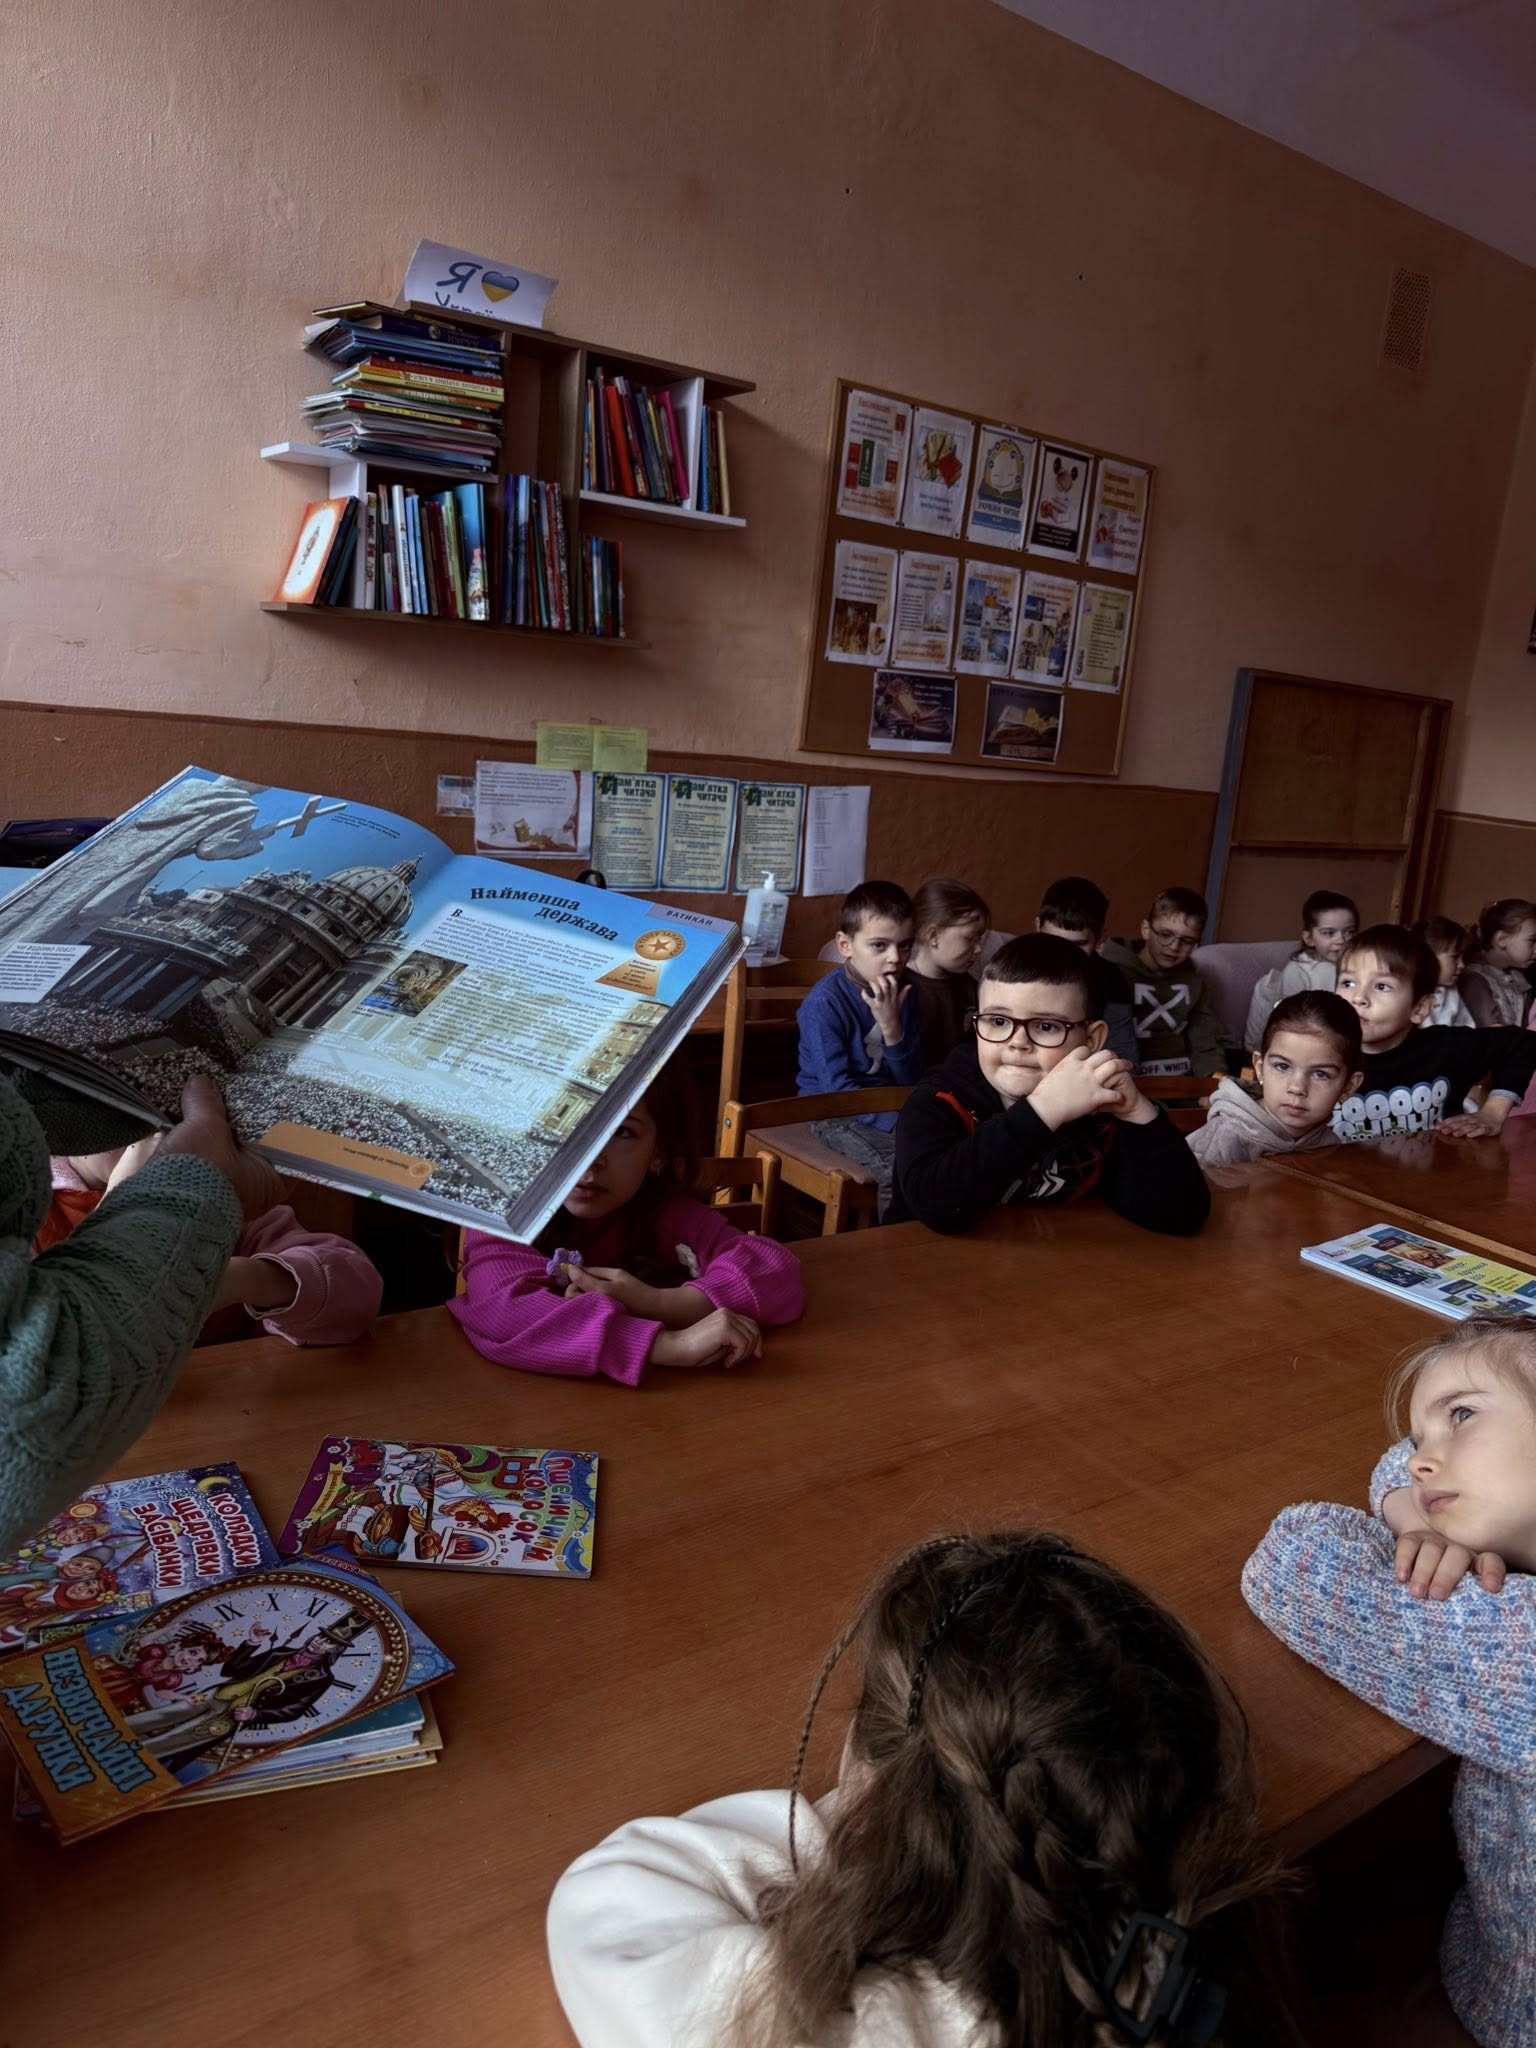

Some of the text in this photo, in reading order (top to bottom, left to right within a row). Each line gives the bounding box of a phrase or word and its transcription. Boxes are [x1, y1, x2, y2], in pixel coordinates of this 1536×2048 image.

[436, 262, 483, 293] Я
[623, 788, 656, 798] читача
[696, 792, 727, 803] читача
[766, 799, 796, 808] читача
[471, 887, 581, 911] Найменша
[534, 906, 619, 941] держава
[666, 910, 713, 926] ВАТИКАН
[1140, 1061, 1189, 1074] OFF WHITE
[510, 1469, 548, 1544] КОЛОСОК
[525, 1457, 575, 1562] ПШЕНИЧНИЙ
[170, 1497, 223, 1577] ЩЕДРІВКИ
[208, 1493, 261, 1567] КОЛЯДКИ
[131, 1503, 185, 1589] ЗАСІВАНКИ
[214, 1600, 245, 1622] IX
[266, 1592, 281, 1612] X
[300, 1597, 331, 1618] XI
[42, 1647, 156, 1794] НЕЗВИЧАЙНІ
[0, 1682, 97, 1793] ДАРУНКИ
